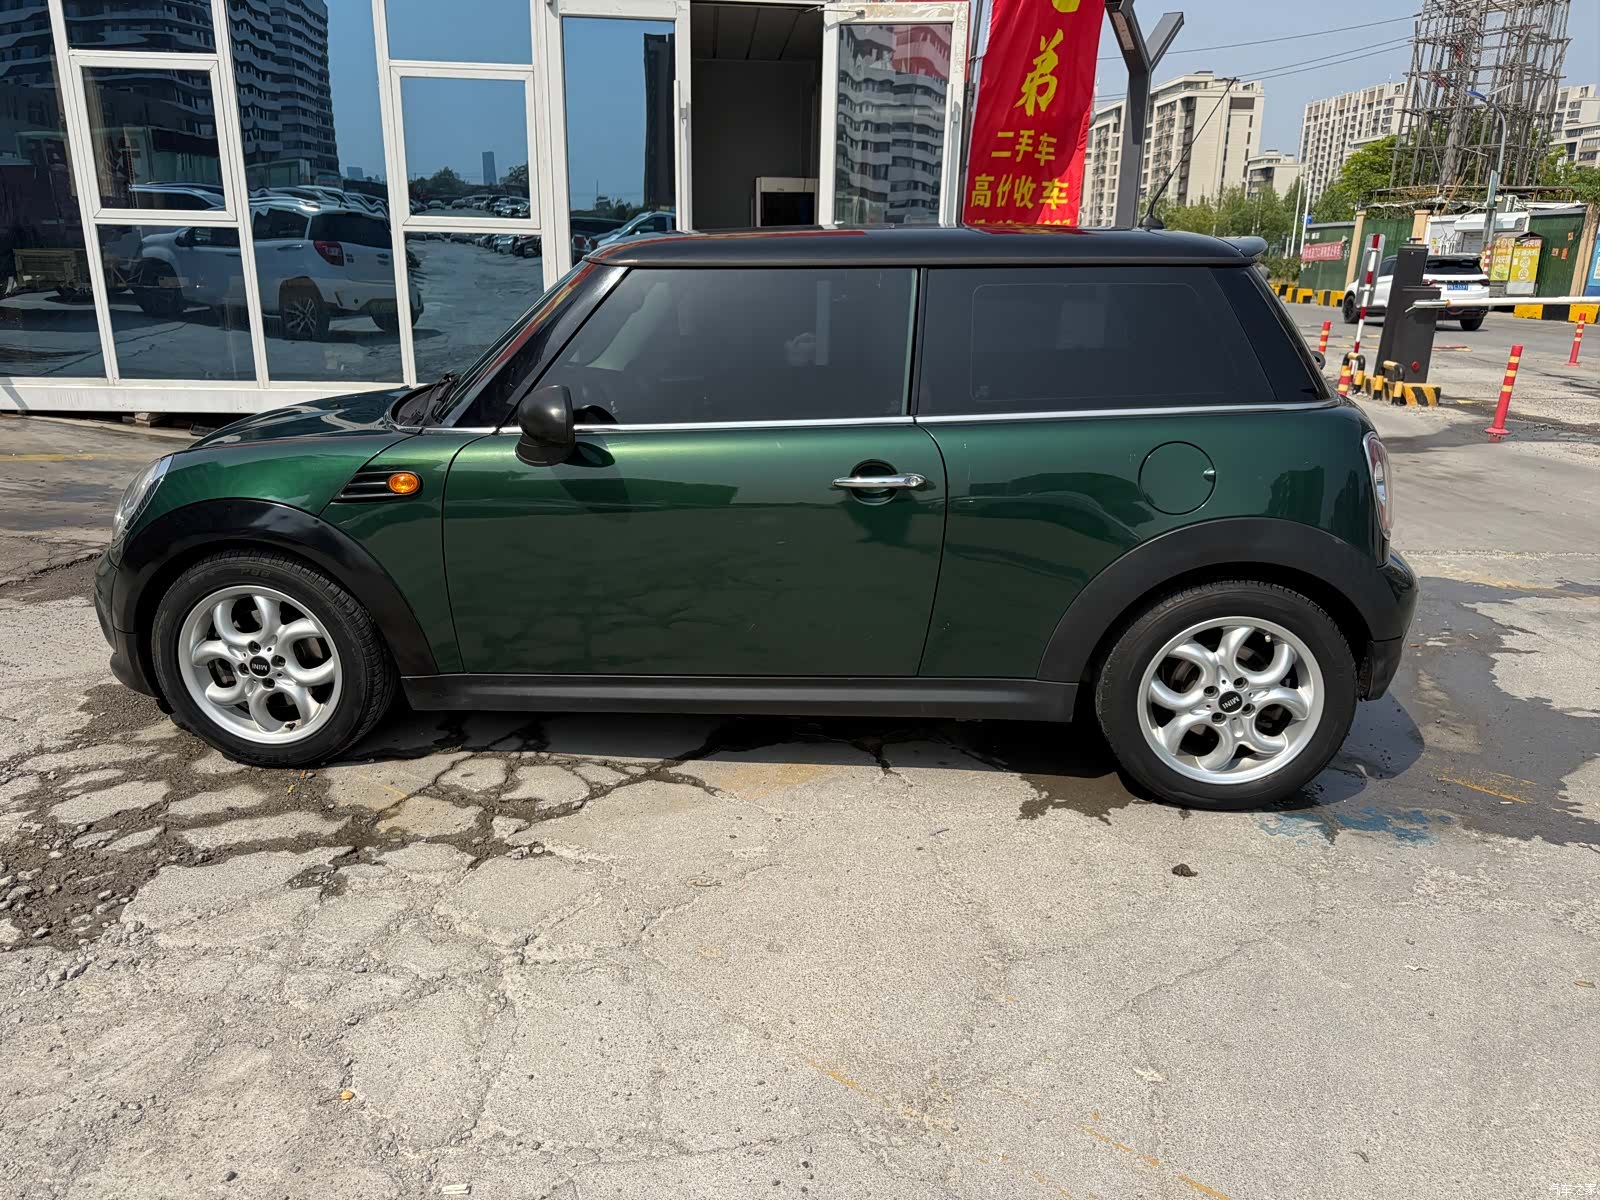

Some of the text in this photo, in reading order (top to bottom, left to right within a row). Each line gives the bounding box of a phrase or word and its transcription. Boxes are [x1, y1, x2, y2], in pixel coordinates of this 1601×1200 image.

[1013, 28, 1064, 117] 弟
[991, 130, 1057, 167] 二手车
[971, 173, 1069, 209] 高价收车
[252, 663, 268, 671] MINI
[1222, 696, 1239, 709] MINI
